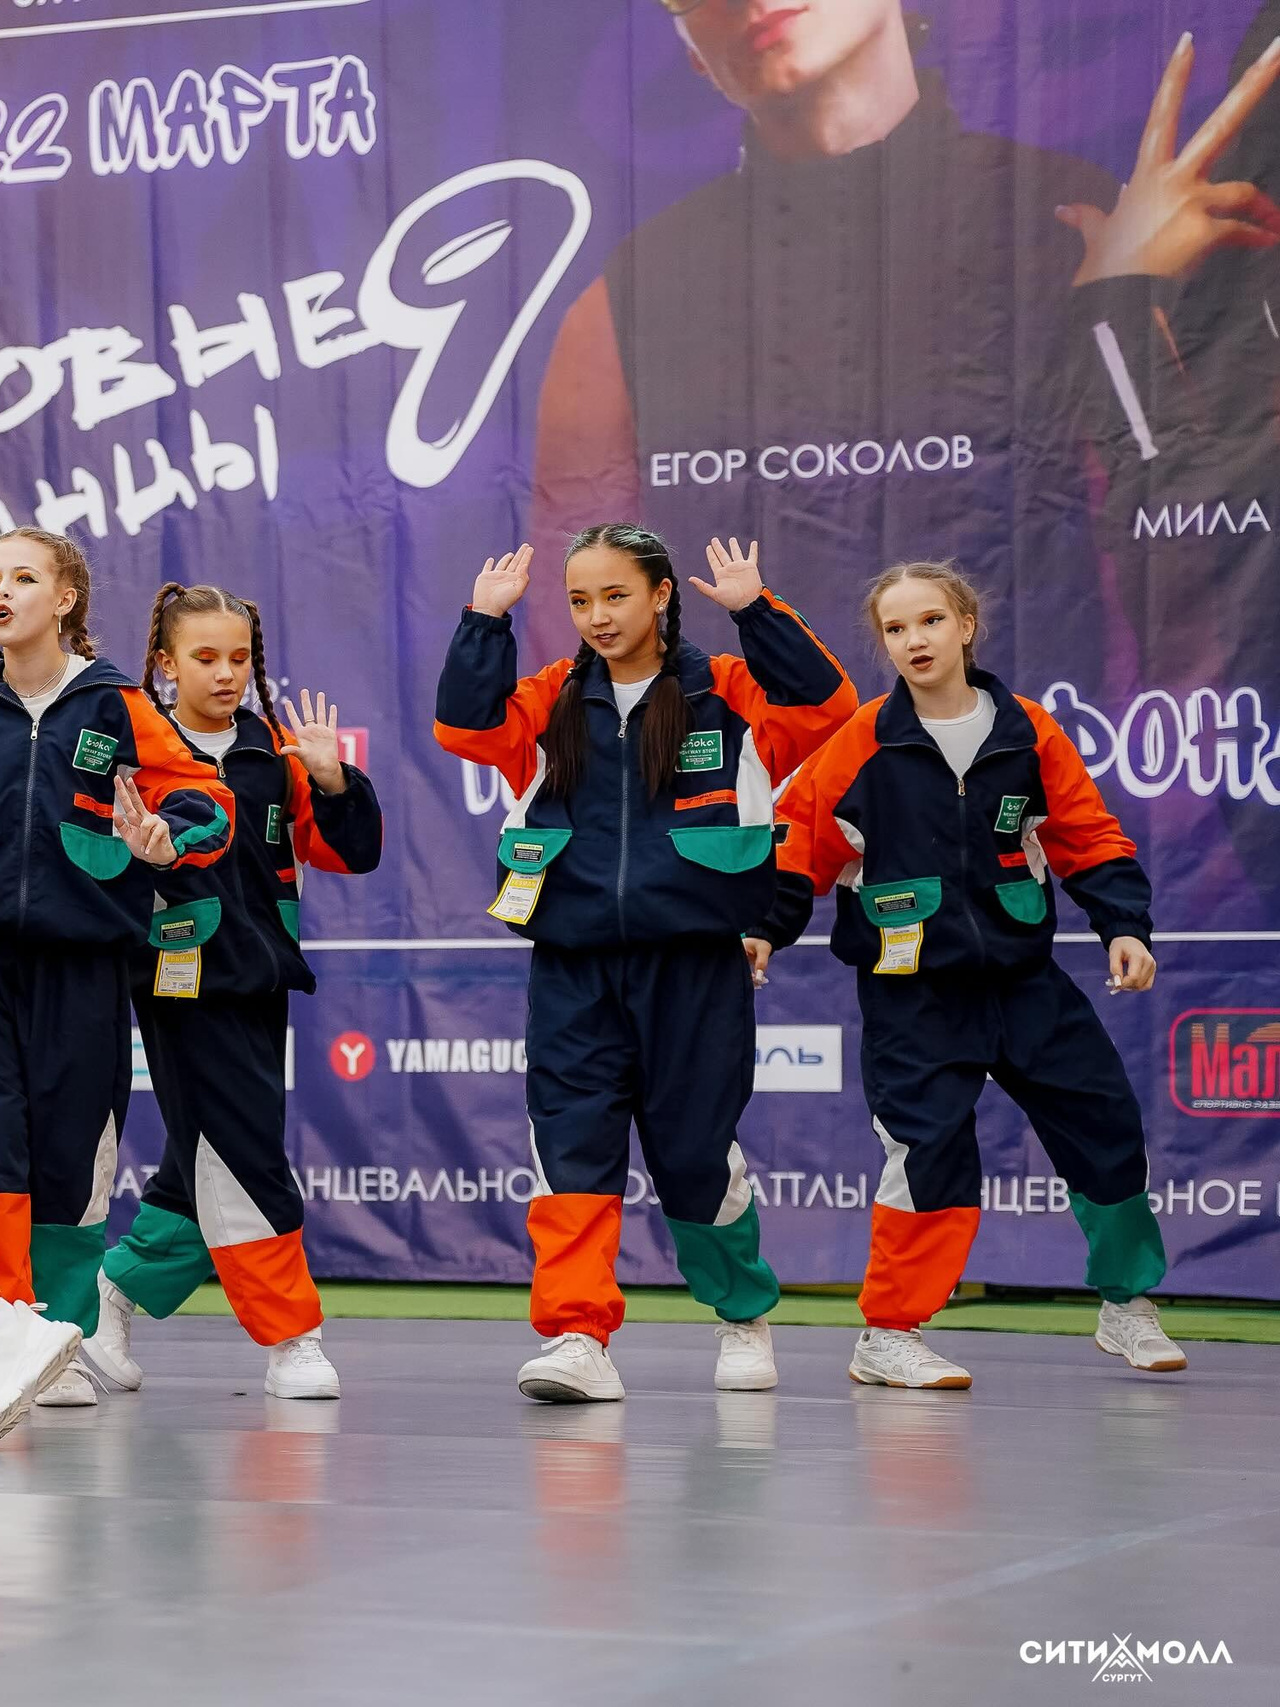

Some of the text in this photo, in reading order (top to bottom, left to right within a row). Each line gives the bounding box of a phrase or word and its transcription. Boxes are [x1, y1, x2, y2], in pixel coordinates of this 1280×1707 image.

[88, 55, 377, 175] МАРТА
[650, 434, 974, 487] ЕГОР СОКОЛОВ
[1133, 498, 1273, 540] МИЛА
